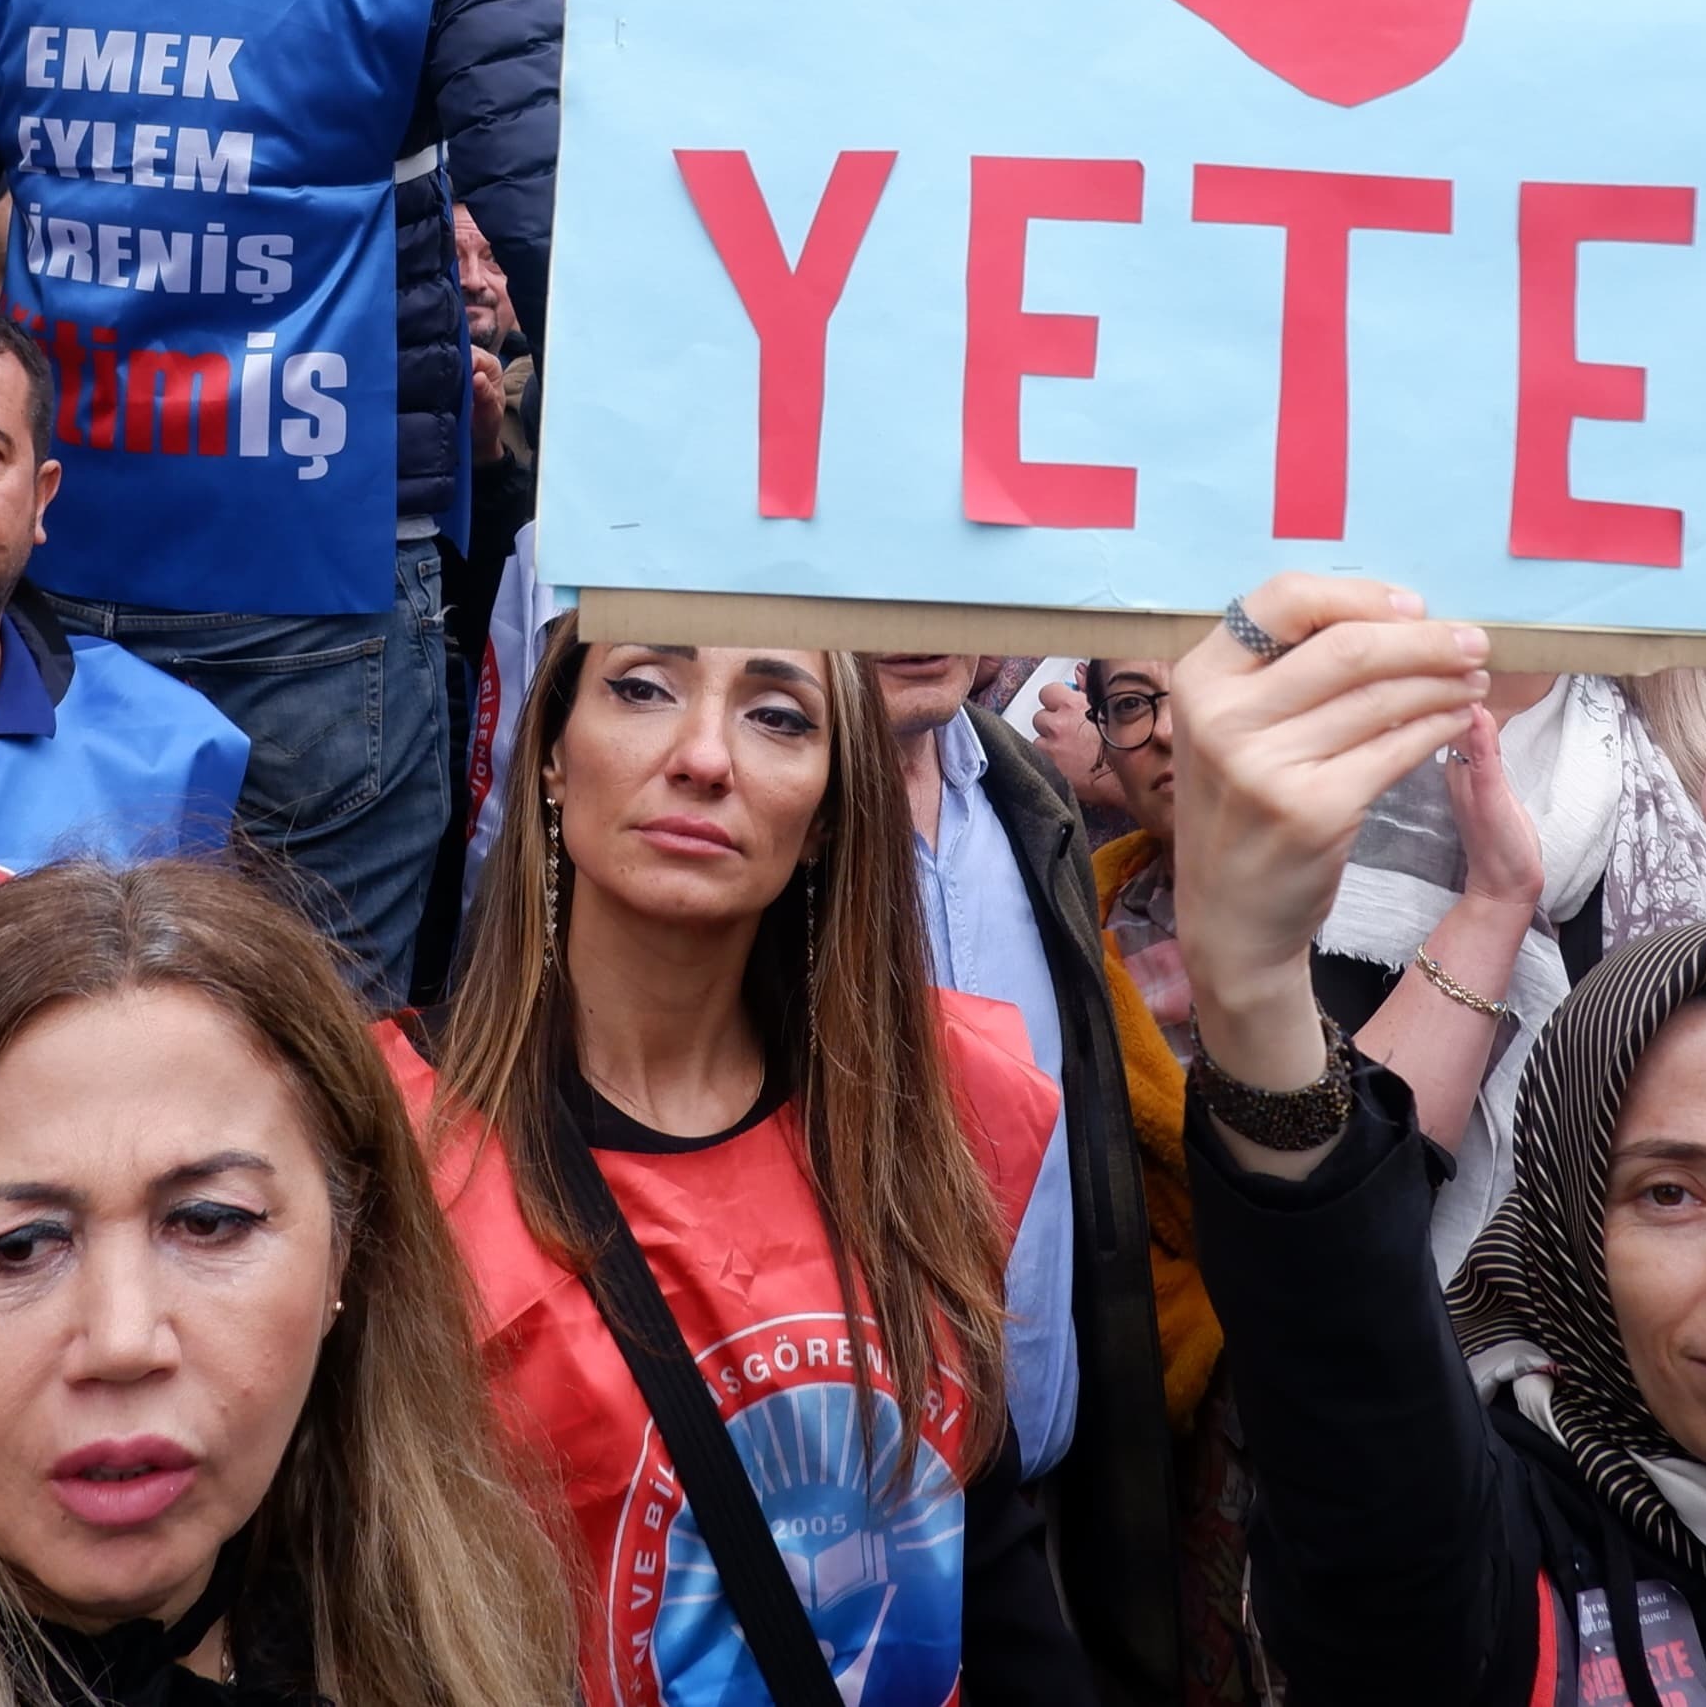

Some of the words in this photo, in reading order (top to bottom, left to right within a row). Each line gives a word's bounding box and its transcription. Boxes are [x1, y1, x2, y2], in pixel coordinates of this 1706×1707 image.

[25, 25, 245, 102] EMEK
[17, 115, 255, 195] EYLEM
[770, 1512, 848, 1541] 2005
[628, 1548, 658, 1612] VE
